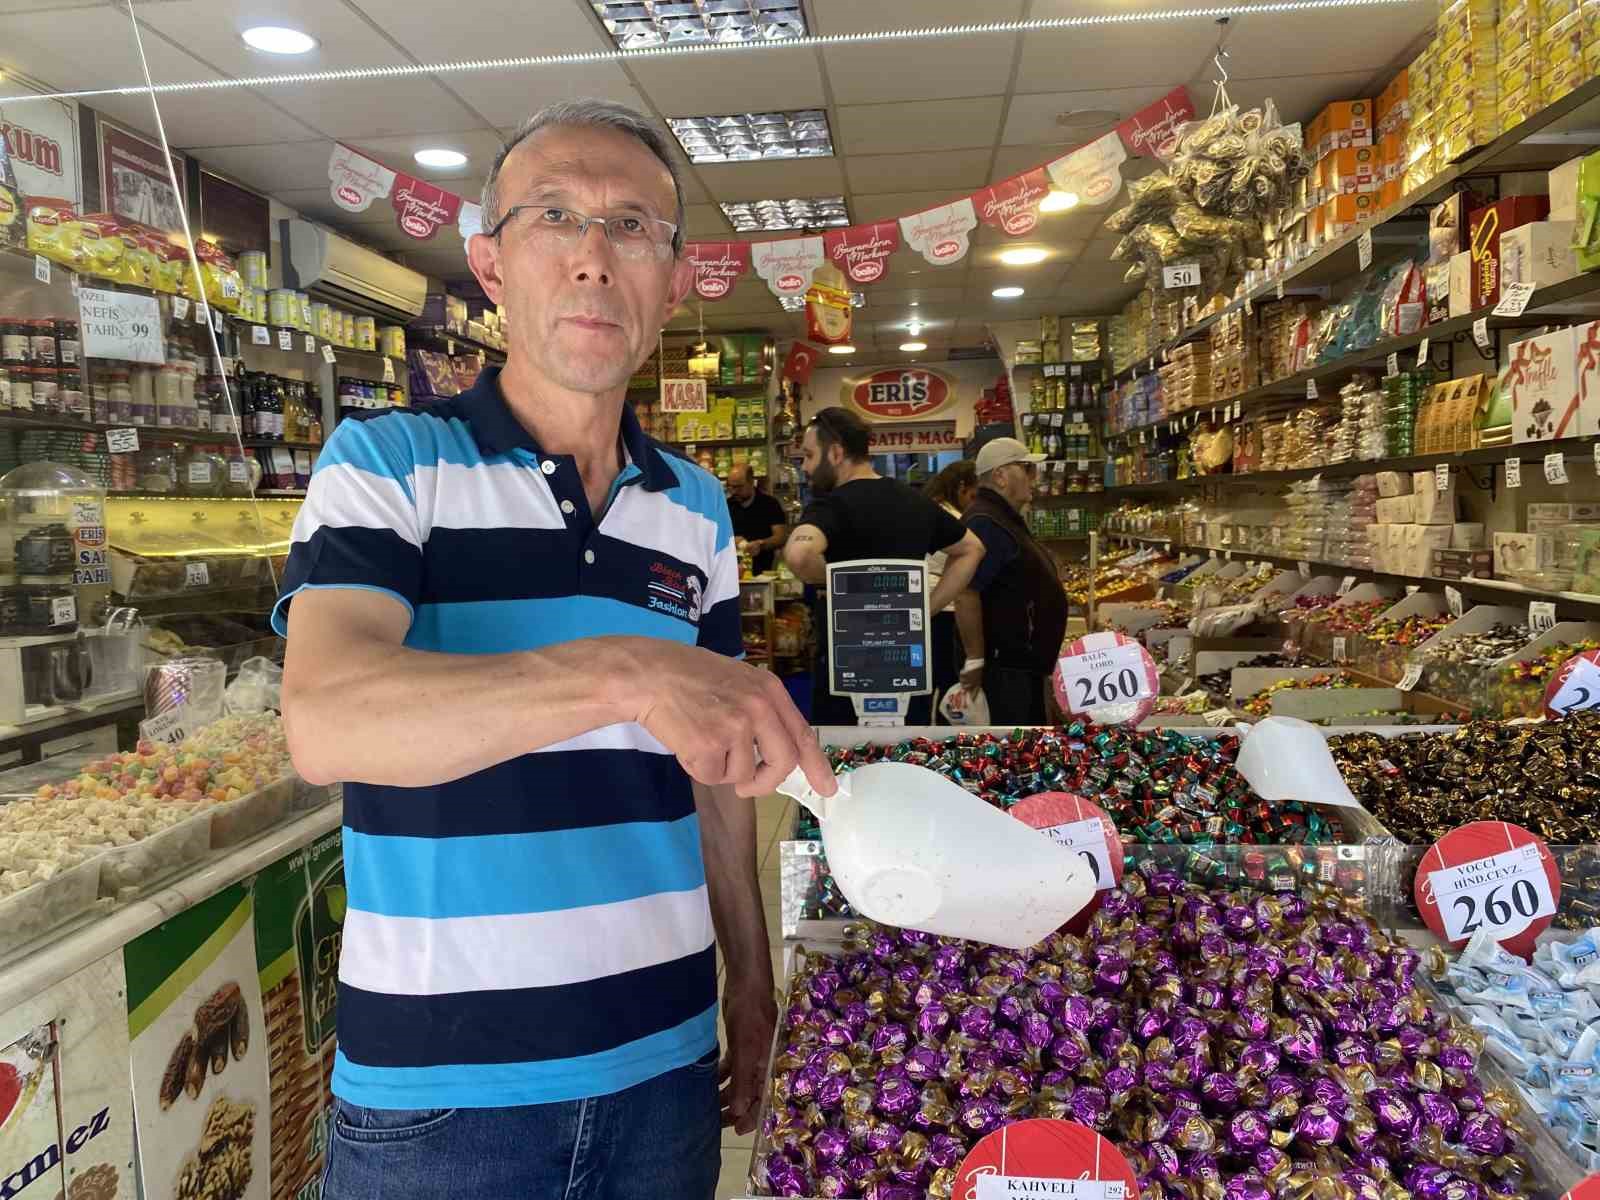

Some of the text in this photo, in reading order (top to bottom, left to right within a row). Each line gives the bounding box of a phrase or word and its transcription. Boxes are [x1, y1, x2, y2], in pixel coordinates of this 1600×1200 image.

[1173, 271, 1192, 286] 50
[132, 322, 149, 338] 99
[893, 678, 918, 687] CAS
[1075, 668, 1138, 707] 260
[1453, 879, 1539, 934] 260
[1007, 1179, 1076, 1194] KAHVELİ
